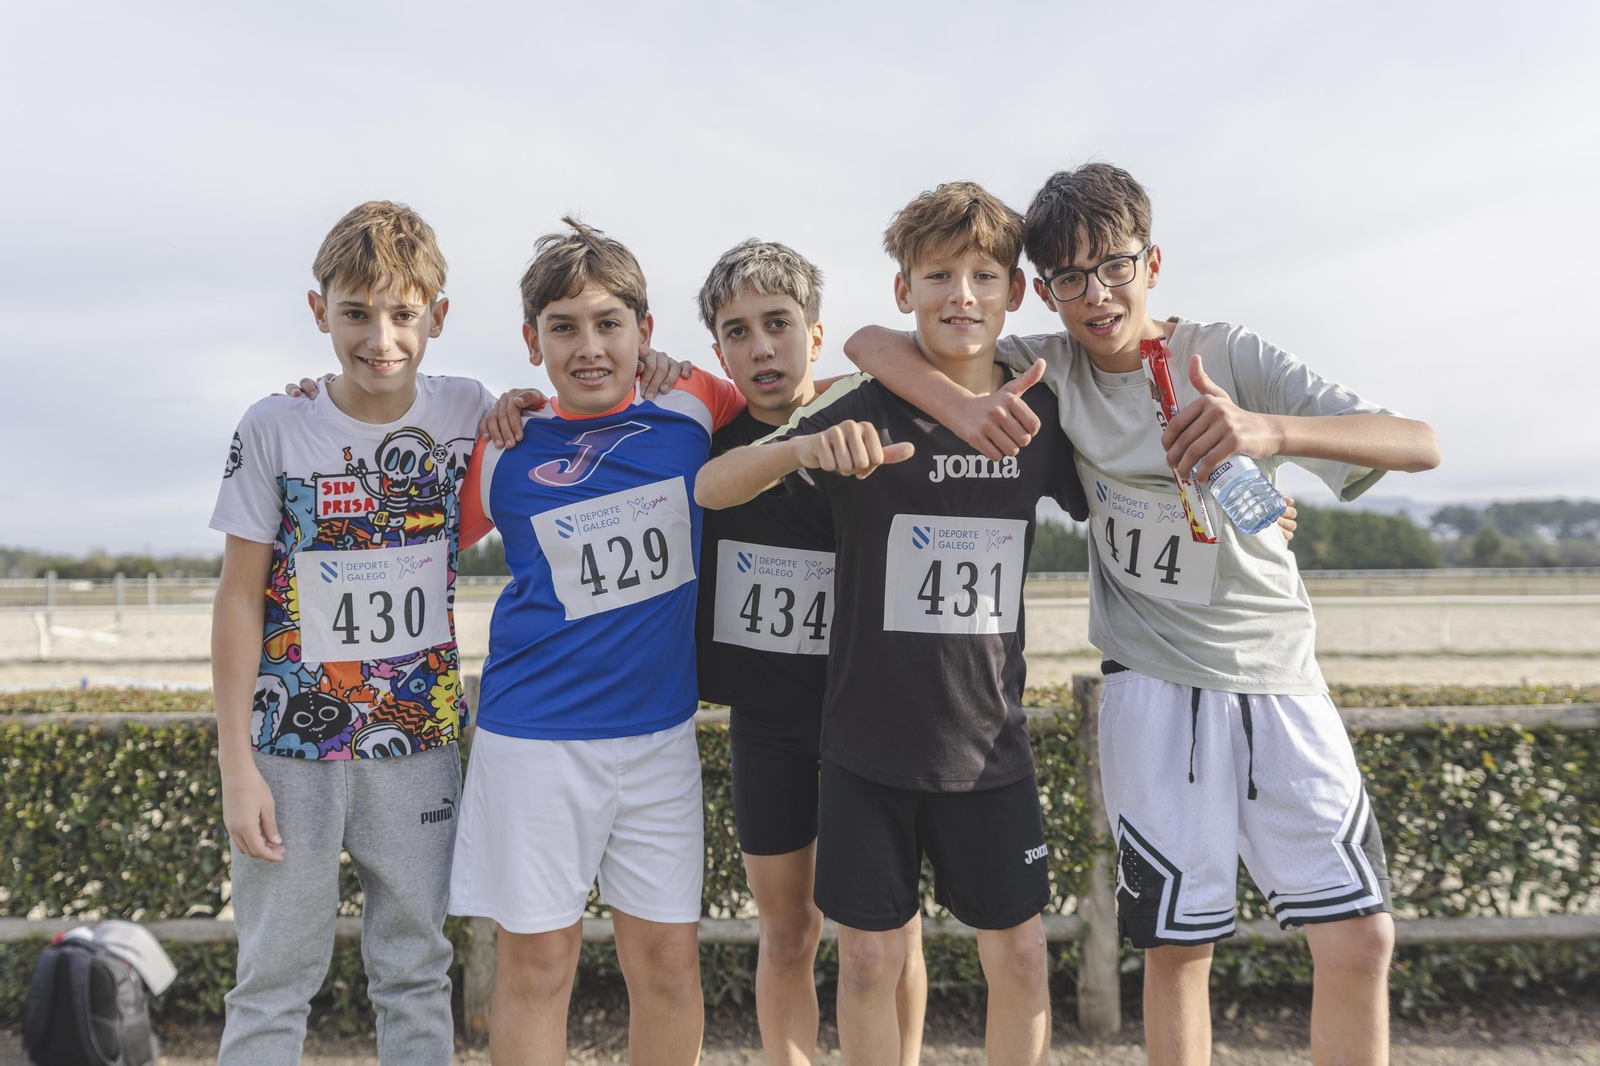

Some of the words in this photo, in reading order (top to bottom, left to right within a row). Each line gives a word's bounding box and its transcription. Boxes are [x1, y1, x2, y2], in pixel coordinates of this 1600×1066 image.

[929, 454, 1021, 483] Joma
[321, 481, 355, 496] SIN
[322, 497, 375, 516] PRISA
[1112, 491, 1149, 511] DEPORTE
[579, 505, 621, 522] DEPORTE
[1112, 502, 1145, 519] GALEGO
[582, 516, 620, 532] GALEGO
[938, 529, 979, 539] DEPORTE
[938, 540, 976, 550] GALEGO
[1105, 516, 1182, 585] 414
[346, 560, 389, 571] DEPORTE
[580, 527, 669, 596] 429
[759, 556, 798, 569] DEPORTE
[347, 571, 387, 582] GALEGO
[758, 566, 794, 578] GALEGO
[917, 560, 1003, 617] 431
[332, 586, 426, 645] 430
[739, 583, 827, 640] 434
[420, 806, 453, 825] PUMA
[1024, 843, 1048, 865] Jom
